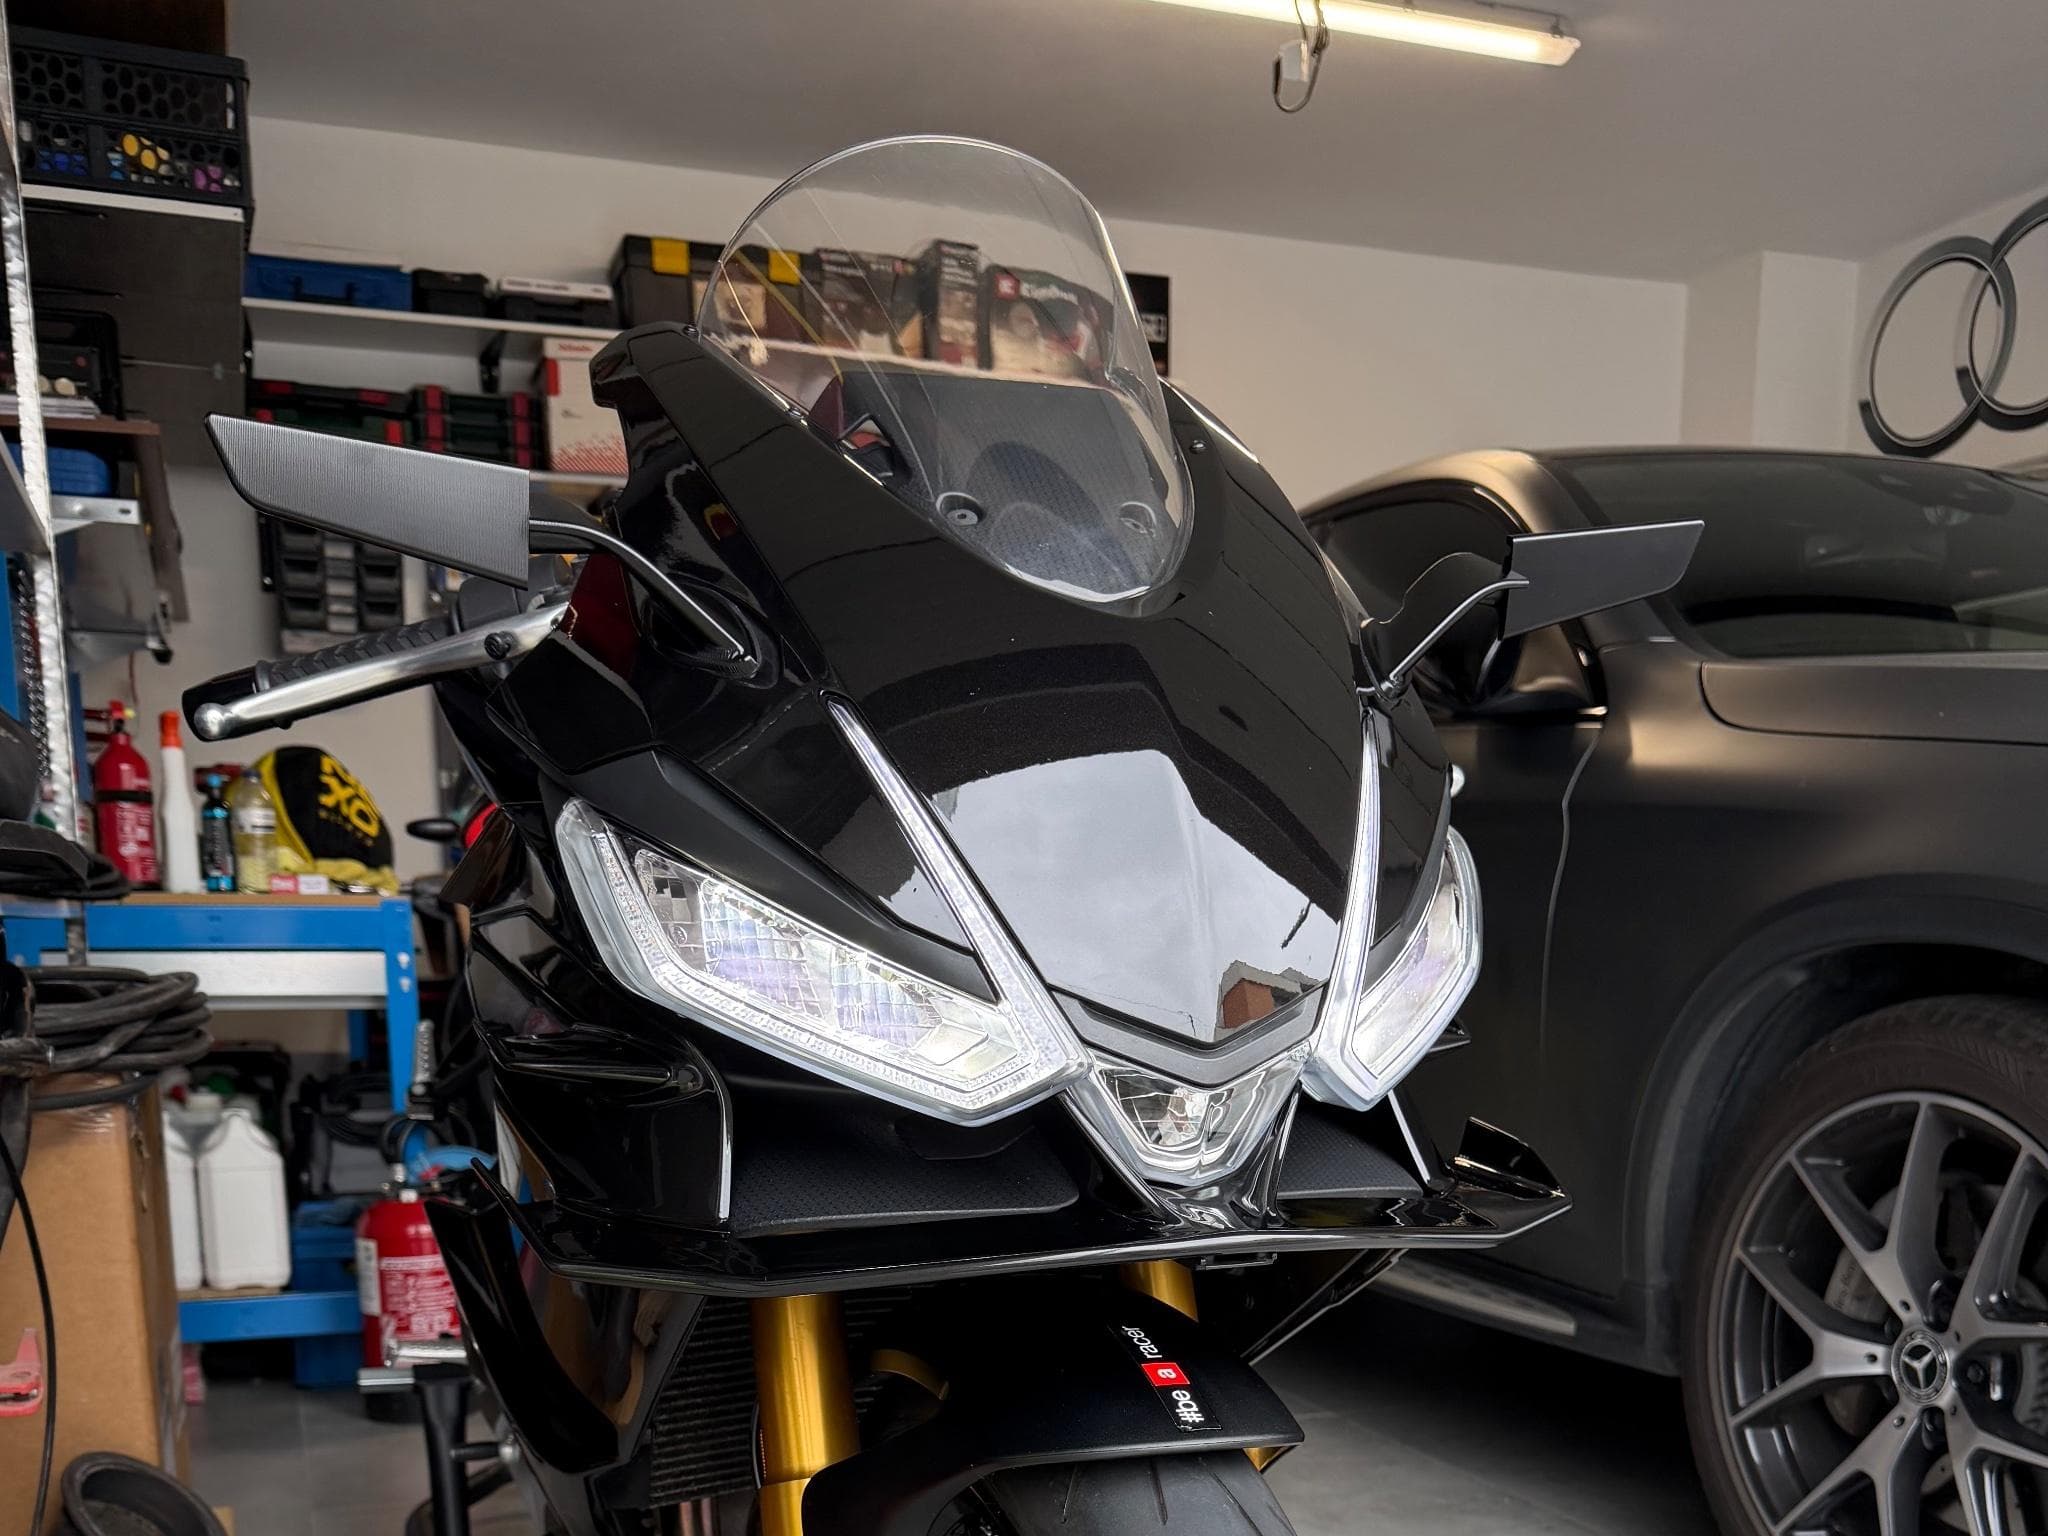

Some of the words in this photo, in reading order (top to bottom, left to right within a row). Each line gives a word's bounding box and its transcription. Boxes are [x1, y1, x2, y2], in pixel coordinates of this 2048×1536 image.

[1121, 1325, 1163, 1359] racer
[1156, 1367, 1177, 1380] a
[1171, 1389, 1205, 1423] #be
